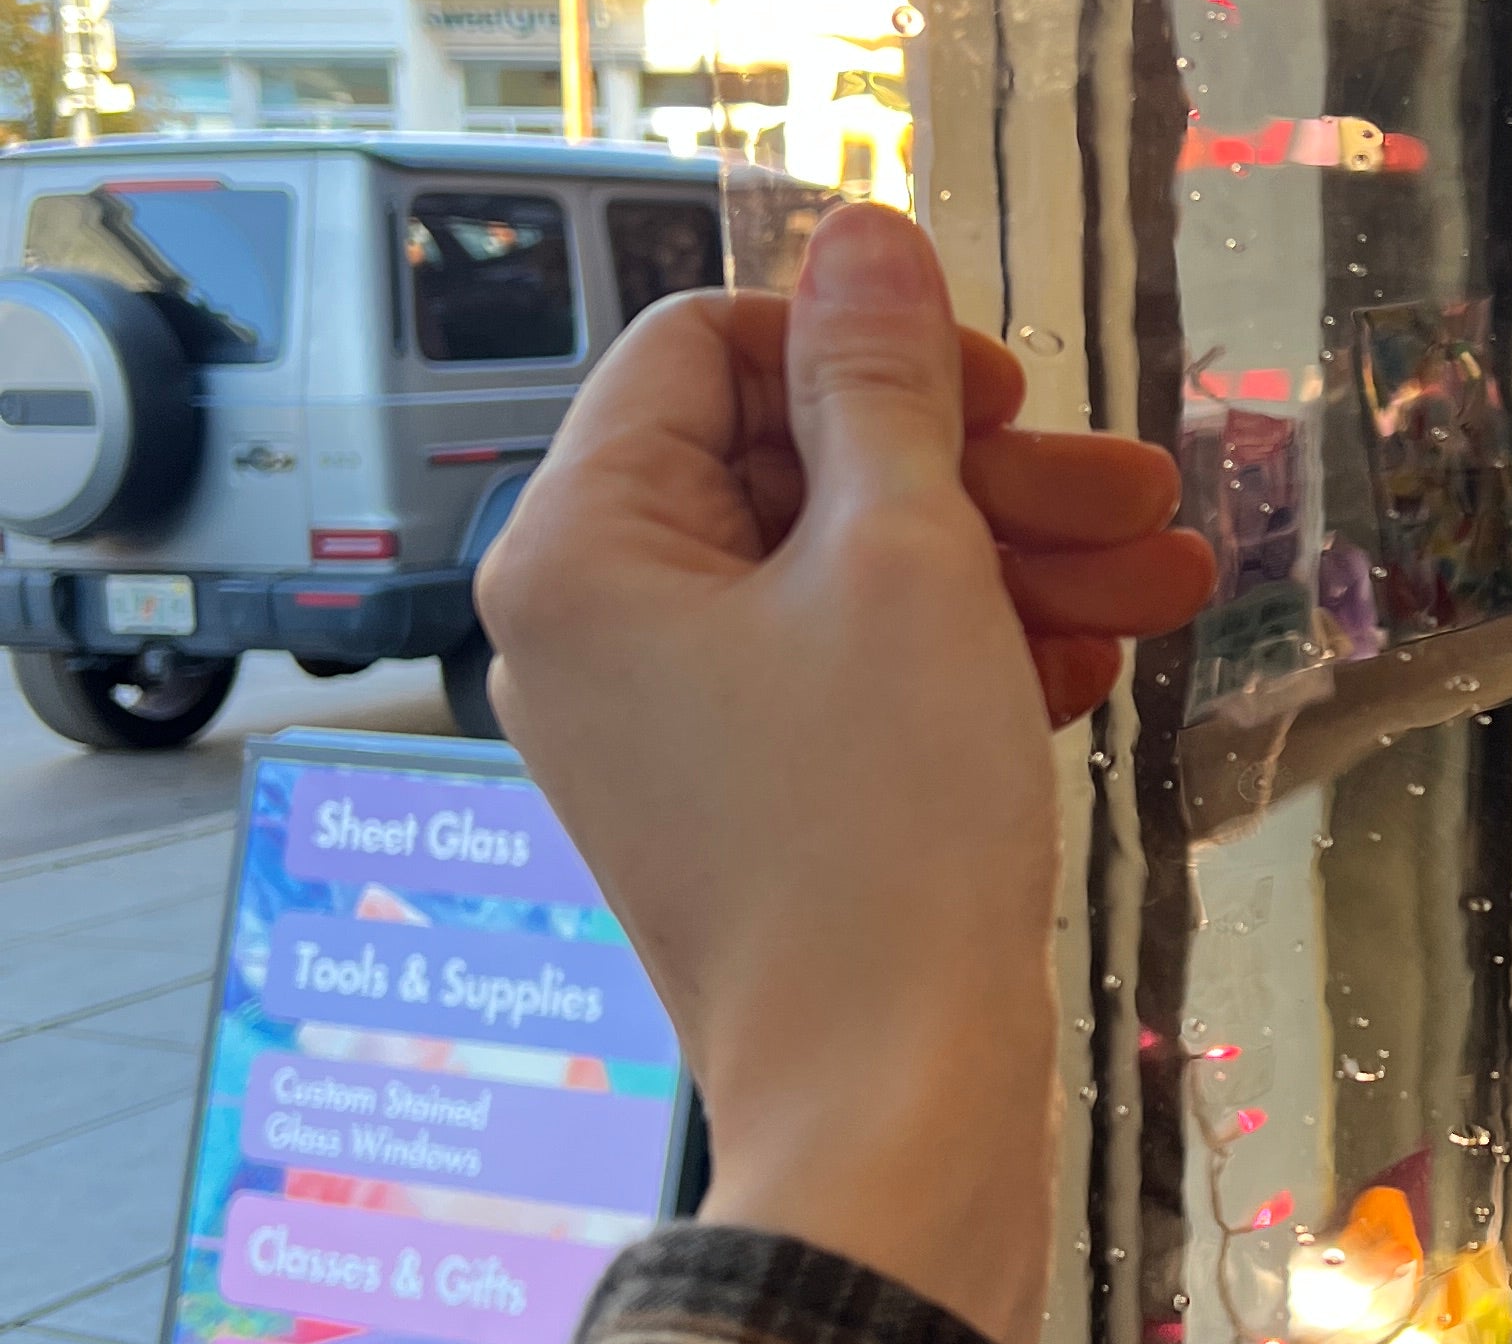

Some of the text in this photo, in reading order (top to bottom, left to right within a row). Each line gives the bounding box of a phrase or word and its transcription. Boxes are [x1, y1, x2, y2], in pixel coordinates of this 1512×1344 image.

[314, 797, 530, 867] Sheet Glass
[294, 940, 603, 1029] Tools & Supplies
[272, 1065, 492, 1131] Custom Stained
[265, 1110, 482, 1177] Glass Windows
[248, 1224, 528, 1316] Classes & Gifts
